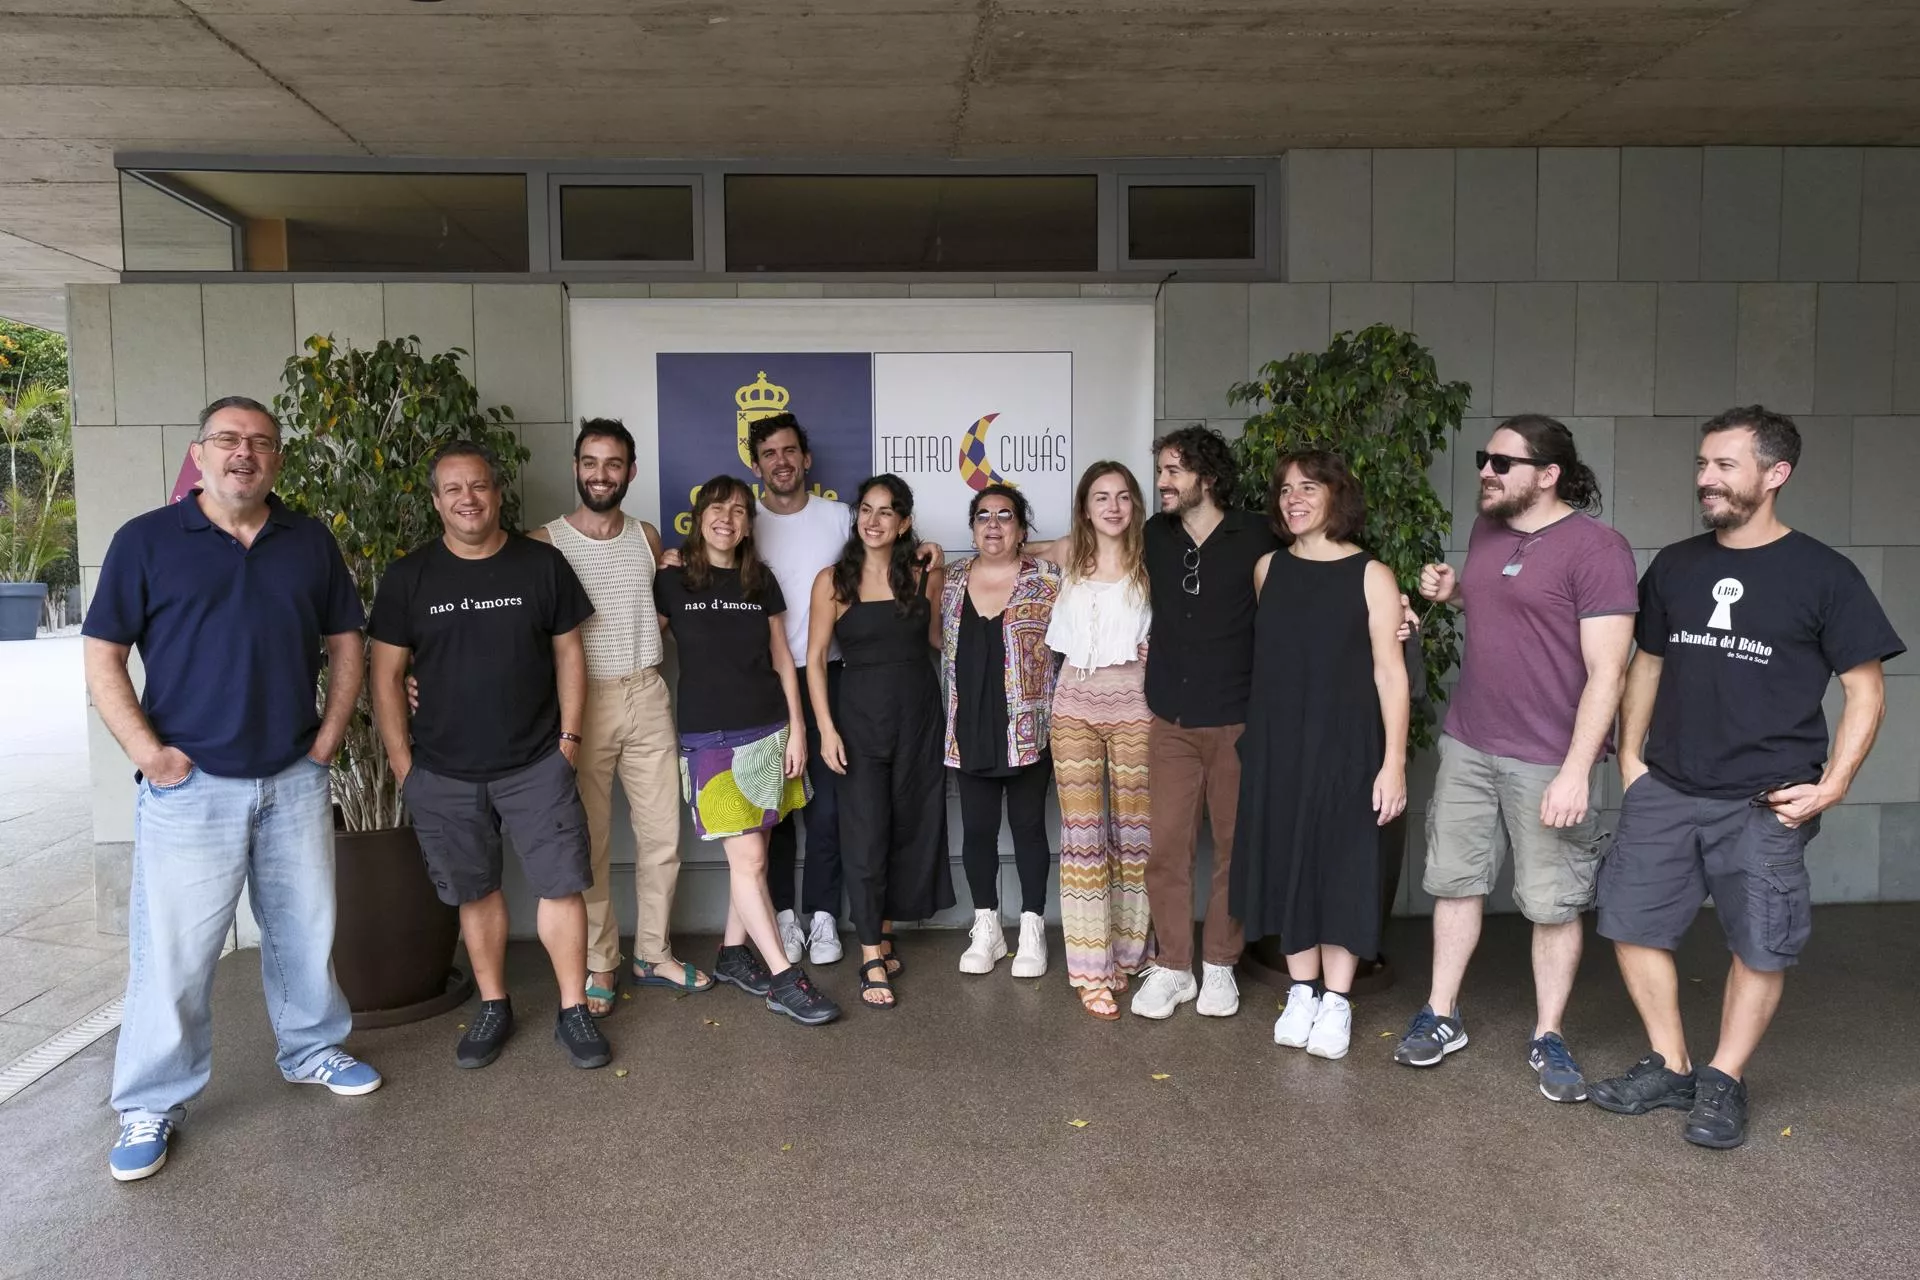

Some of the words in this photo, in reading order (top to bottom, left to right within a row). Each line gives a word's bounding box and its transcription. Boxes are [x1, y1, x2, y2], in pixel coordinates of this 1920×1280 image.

[881, 435, 952, 473] TEATRO
[1000, 428, 1067, 473] CUYÁS
[430, 602, 455, 615] nao
[460, 597, 523, 610] d'amores
[685, 602, 706, 610] nao
[1681, 630, 1718, 647] Banda
[1720, 635, 1736, 649] del
[1738, 637, 1773, 657] Búho
[1735, 652, 1749, 660] Soul
